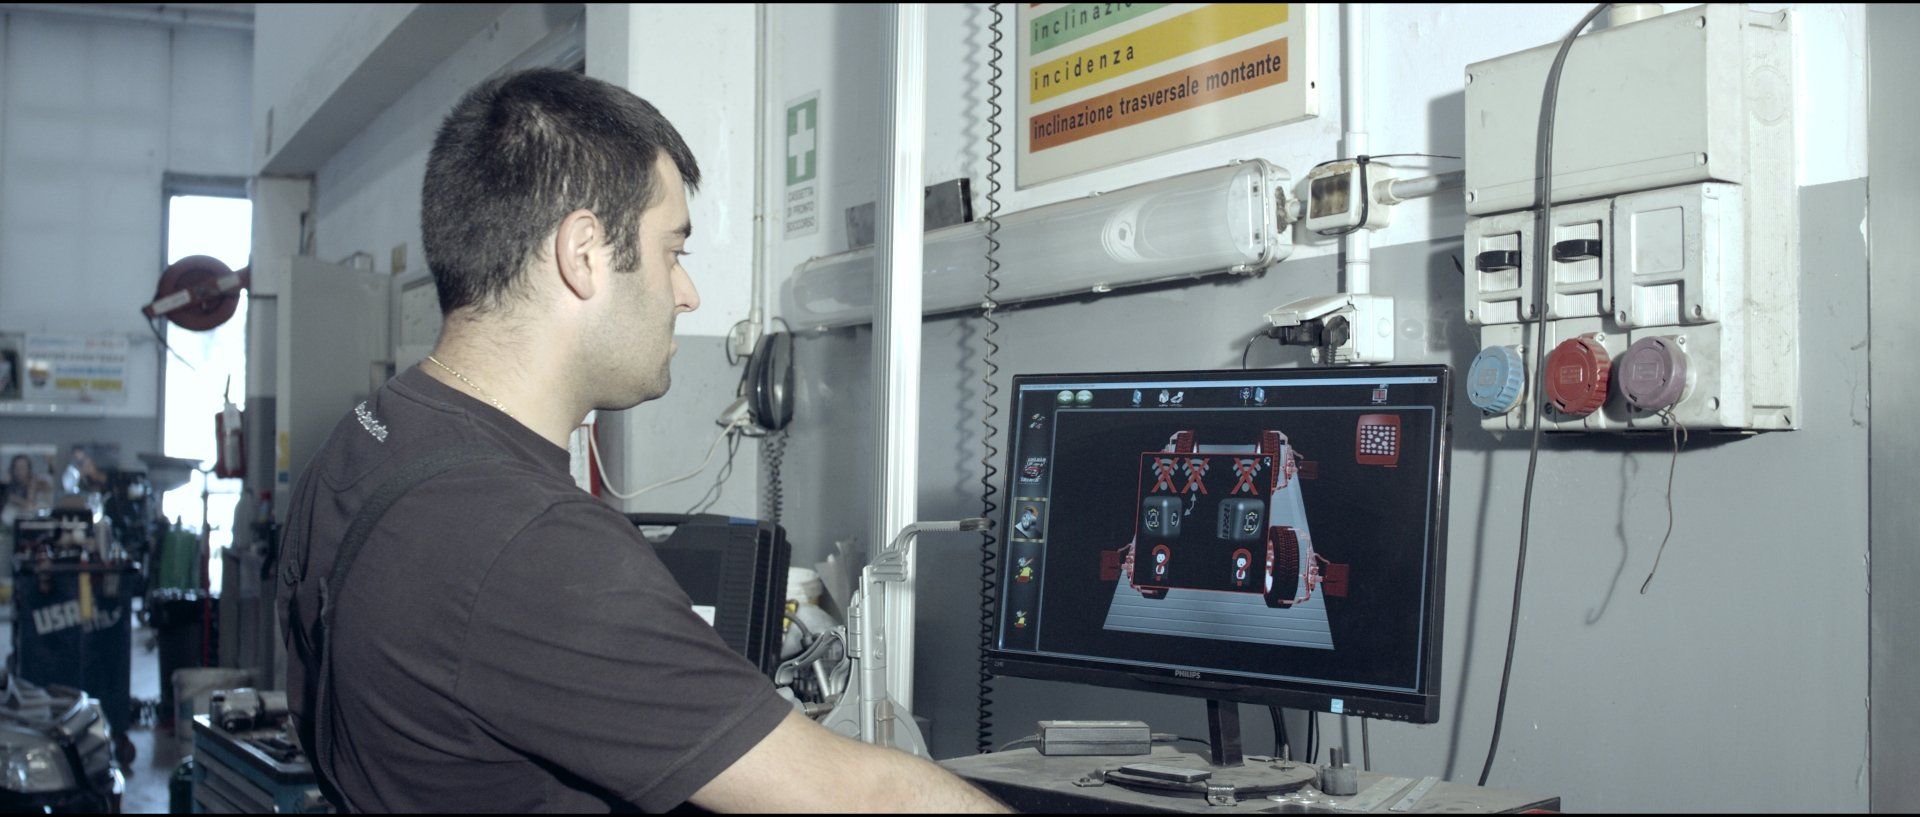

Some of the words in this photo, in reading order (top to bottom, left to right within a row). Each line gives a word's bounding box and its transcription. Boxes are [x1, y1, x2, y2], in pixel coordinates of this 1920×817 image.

[1034, 44, 1135, 91] incidenza
[1033, 102, 1114, 140] inclinazione
[1119, 75, 1199, 116] trasversale
[1206, 53, 1282, 92] montante
[1174, 669, 1201, 680] PHILIPS
